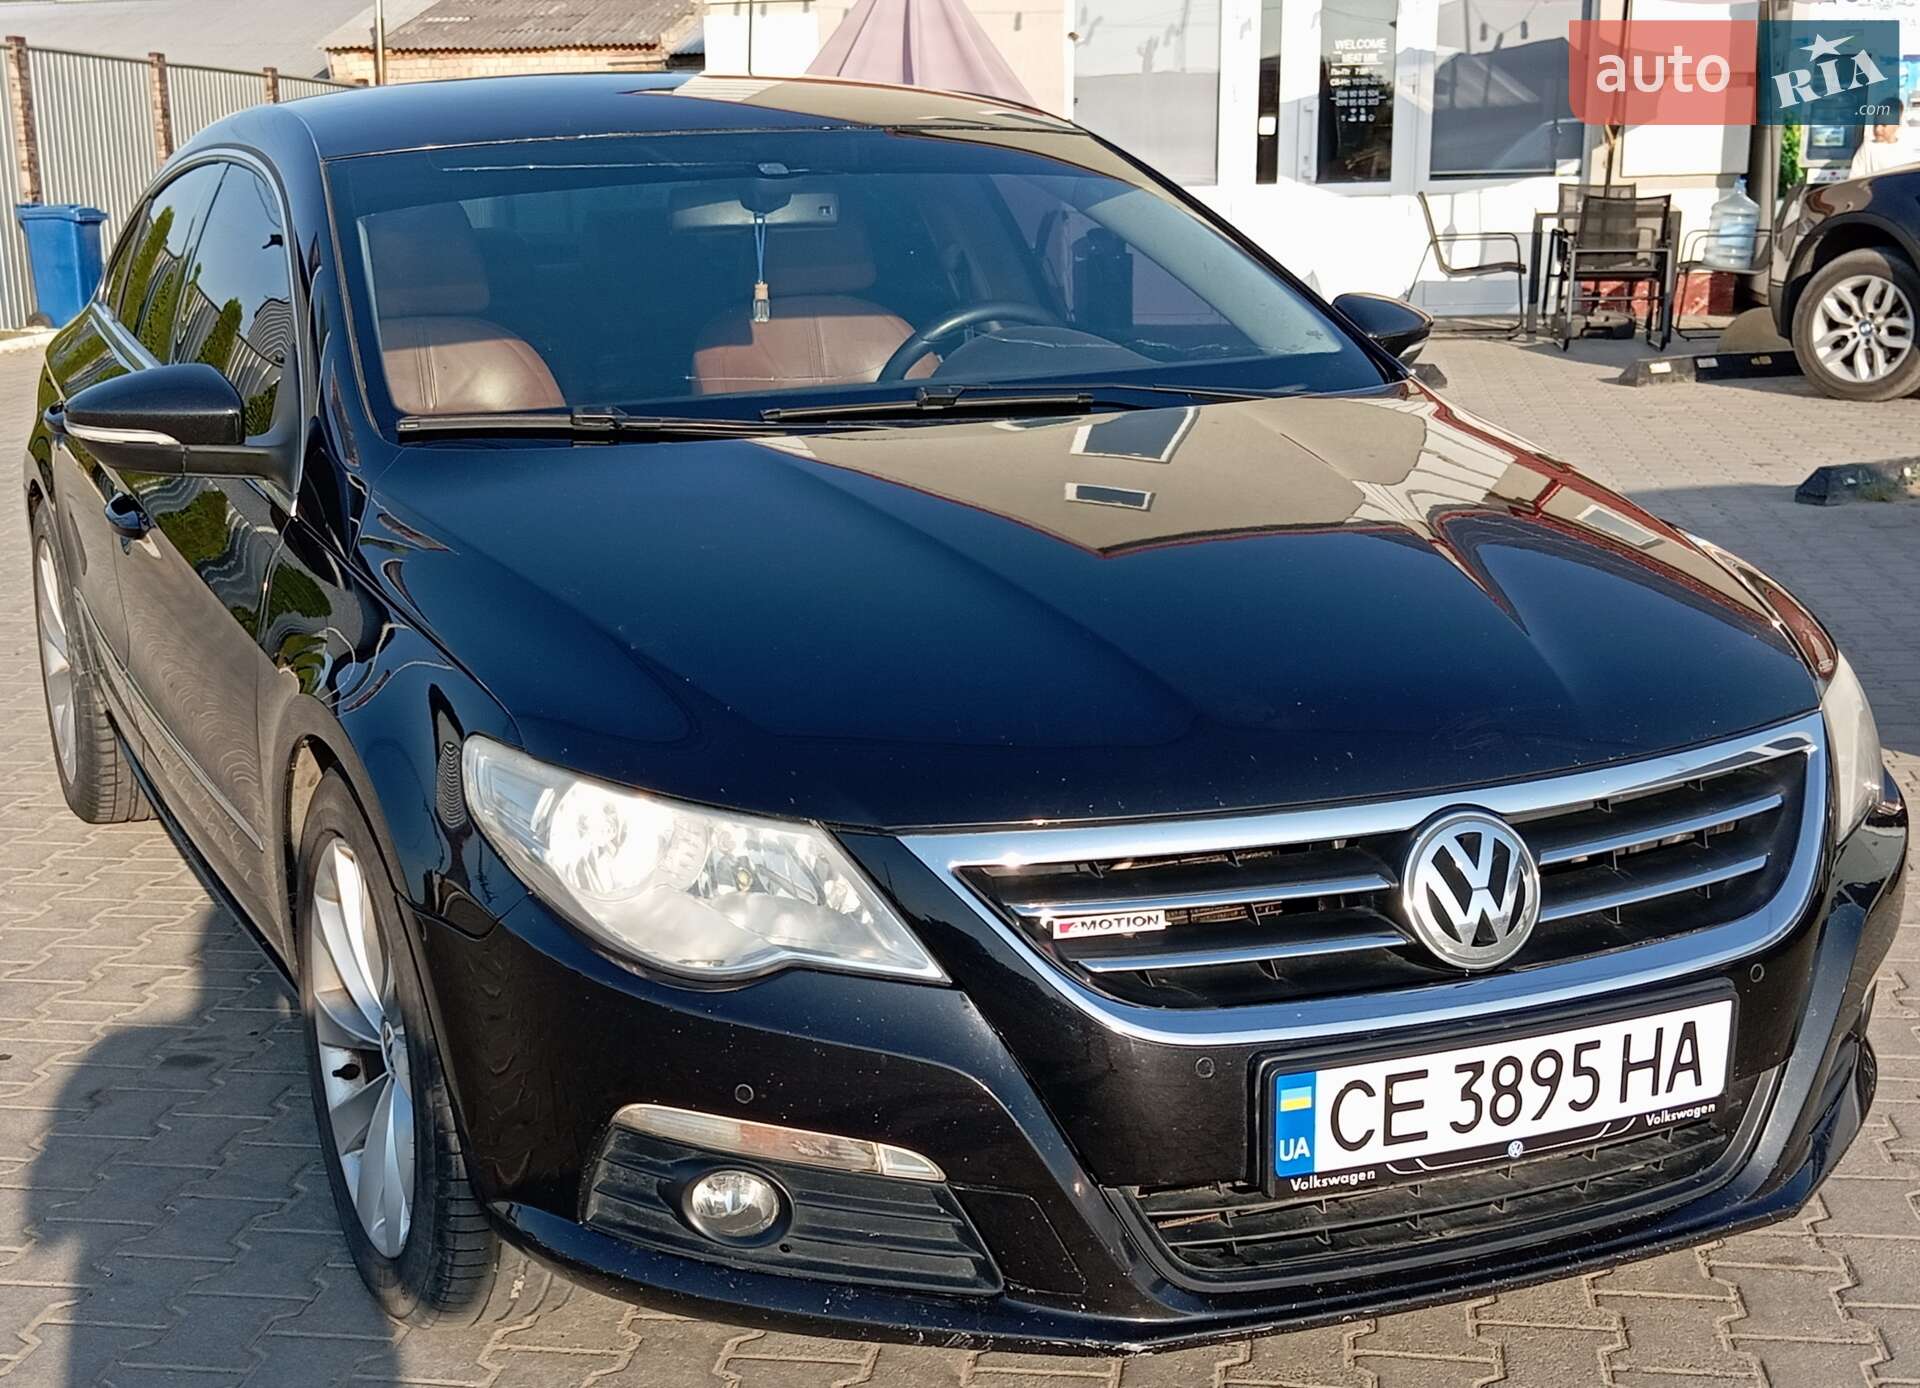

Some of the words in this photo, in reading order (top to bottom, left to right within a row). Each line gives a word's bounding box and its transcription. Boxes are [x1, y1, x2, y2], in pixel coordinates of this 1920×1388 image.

[1334, 38, 1388, 50] WELCOME
[1330, 1068, 1429, 1152] CE
[1450, 1039, 1601, 1134] 3895
[1618, 1020, 1703, 1104] HA
[1645, 1102, 1717, 1128] Volkswagen
[1278, 1136, 1312, 1163] UA
[1289, 1169, 1377, 1193] Volkswagen
